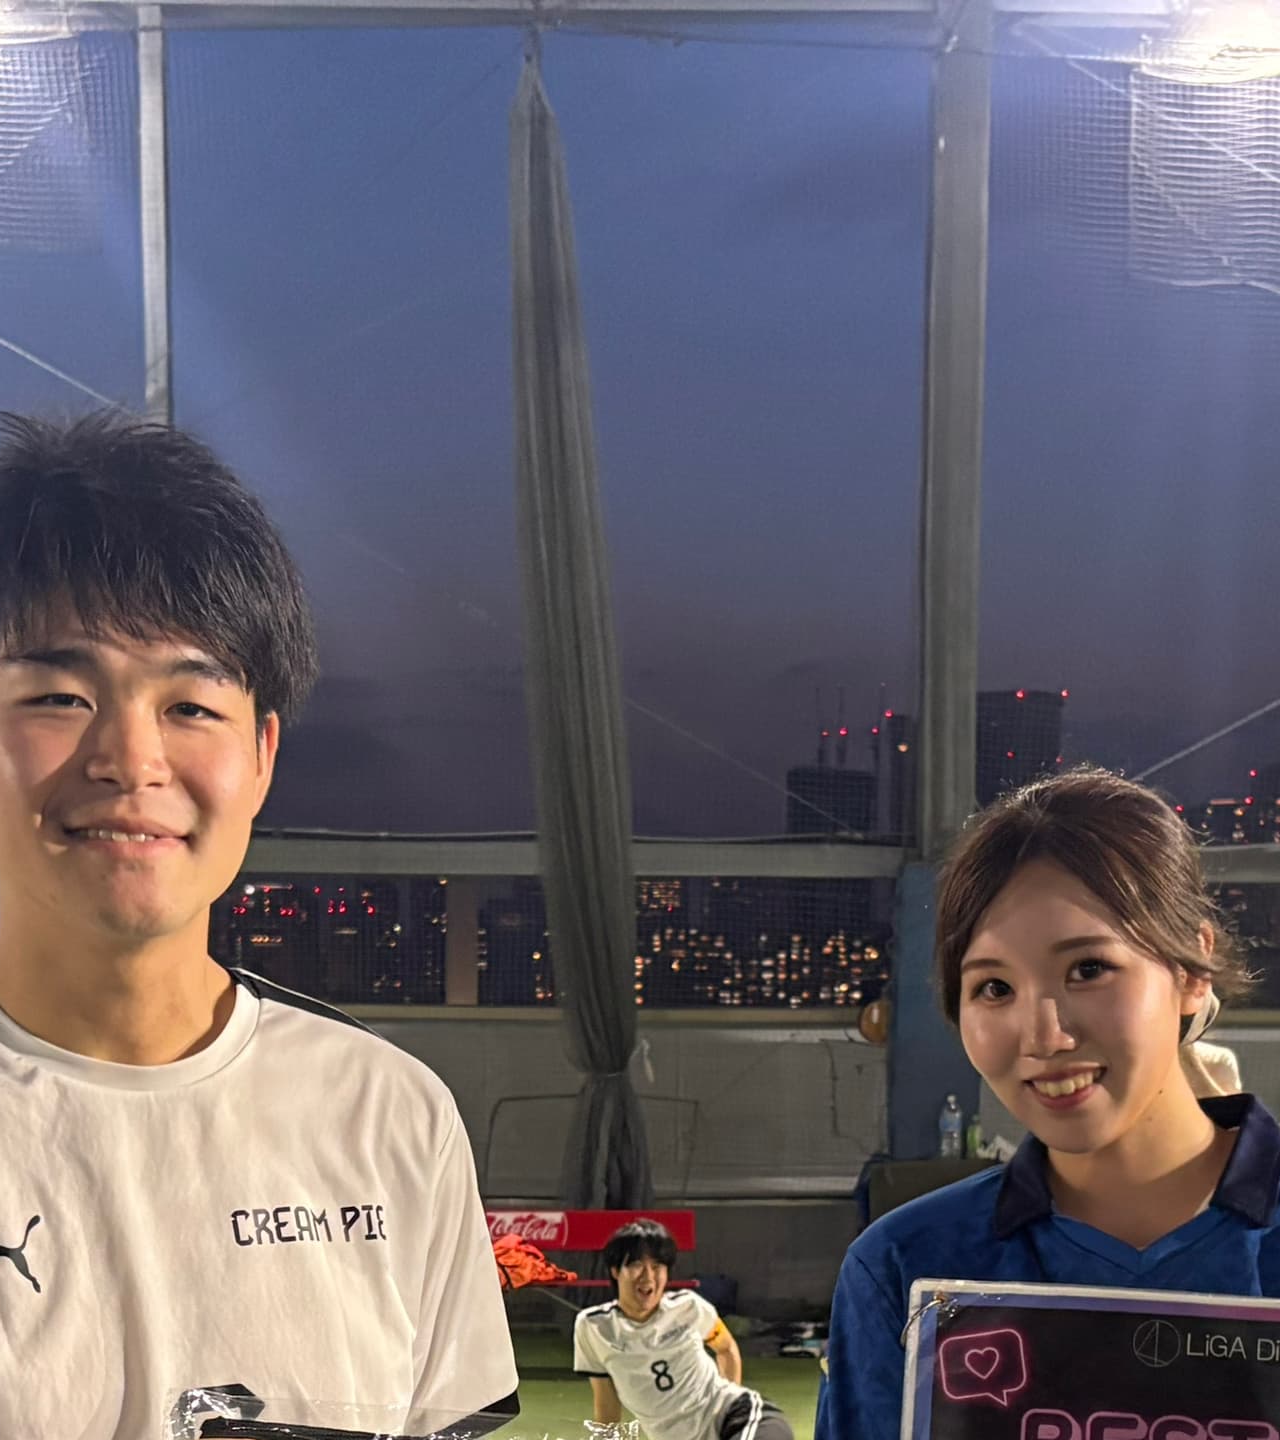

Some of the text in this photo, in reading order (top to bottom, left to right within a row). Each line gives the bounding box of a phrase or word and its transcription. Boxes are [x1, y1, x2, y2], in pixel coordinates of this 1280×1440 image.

[231, 1204, 387, 1247] CREAM PIE
[651, 1360, 674, 1392] 8
